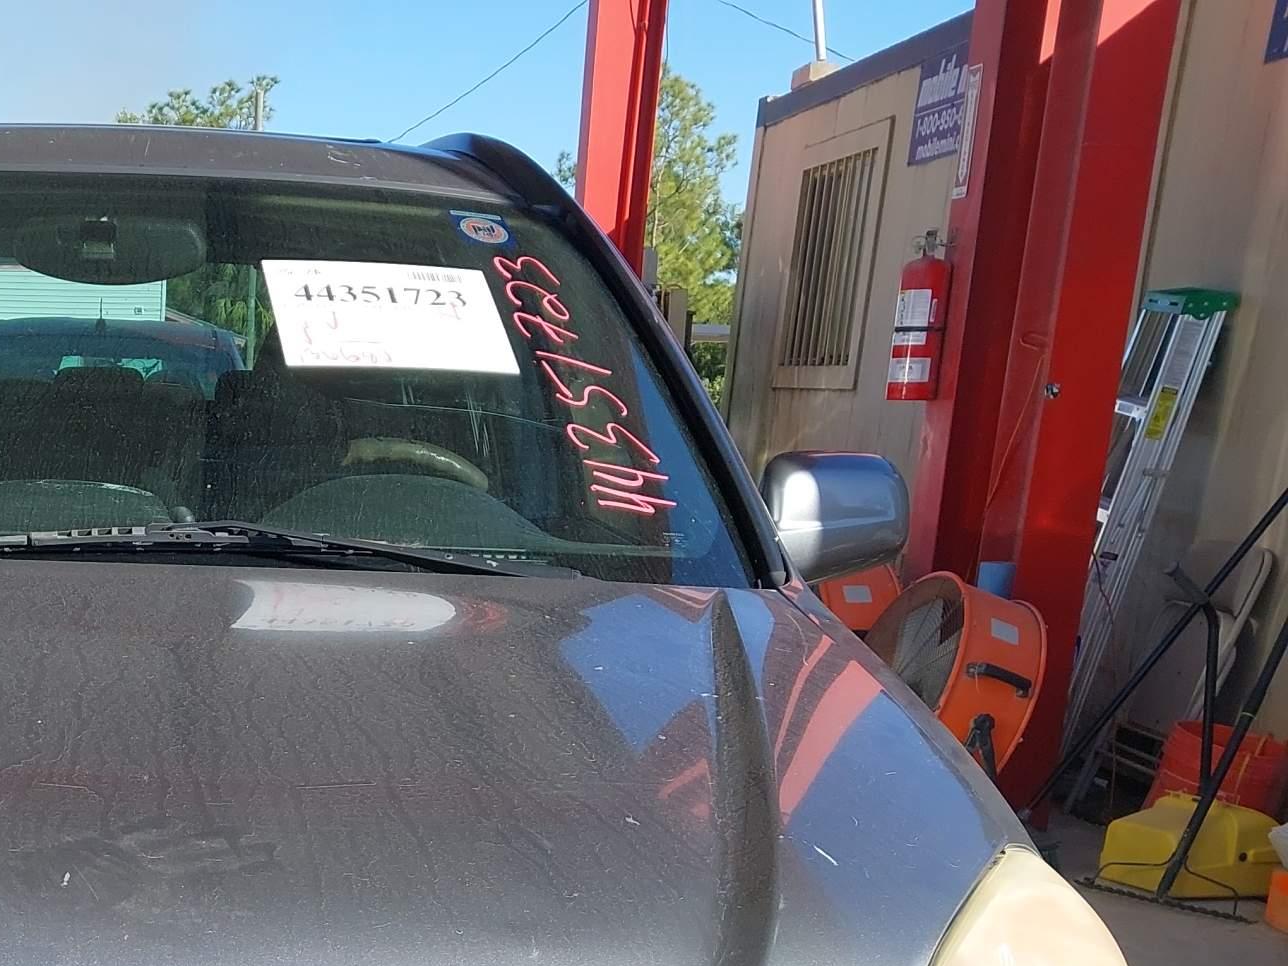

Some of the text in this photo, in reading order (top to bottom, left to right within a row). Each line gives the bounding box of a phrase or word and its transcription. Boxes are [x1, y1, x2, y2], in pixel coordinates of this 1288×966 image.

[917, 54, 960, 108] mobile
[294, 284, 467, 306] 44351723
[493, 255, 678, 515] 44351723
